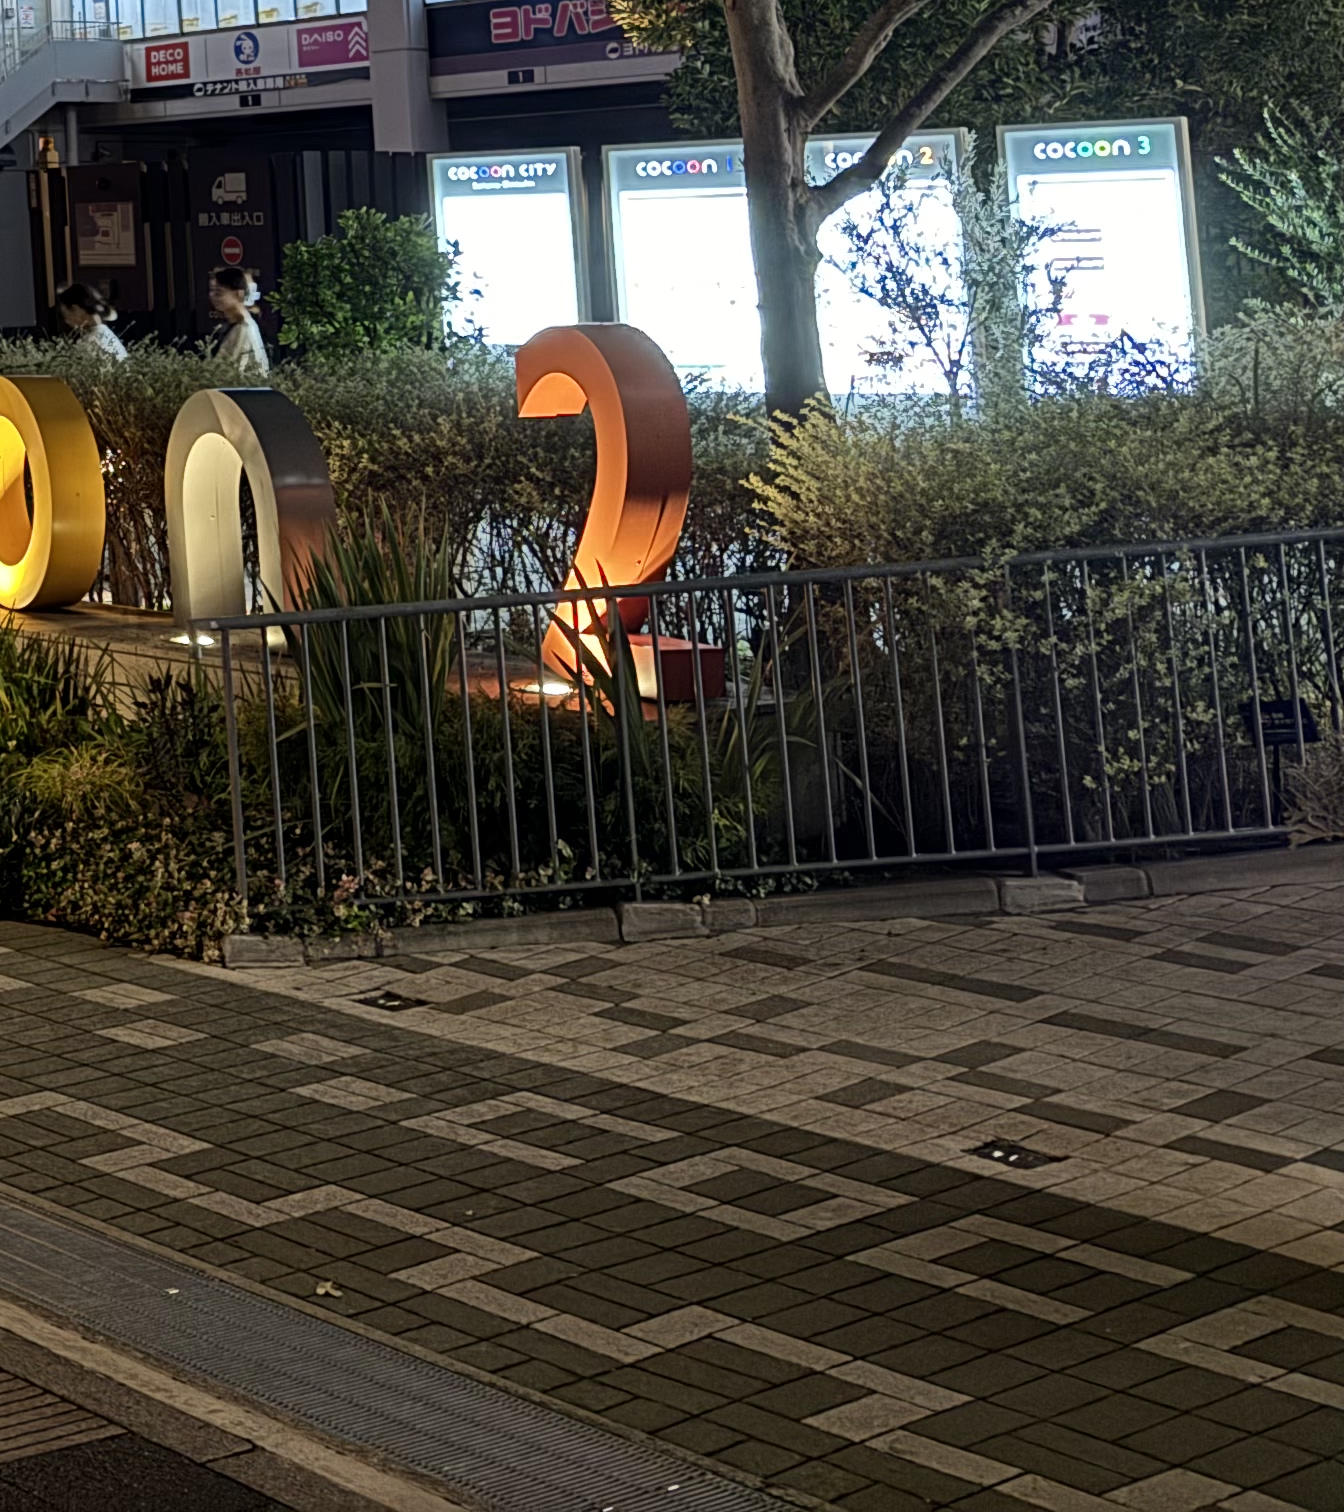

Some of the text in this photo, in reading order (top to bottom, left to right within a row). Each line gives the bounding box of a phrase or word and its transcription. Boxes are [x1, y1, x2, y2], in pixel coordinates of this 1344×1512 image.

[301, 29, 344, 46] DAISO
[150, 48, 184, 63] DECO
[151, 63, 185, 77] HOME
[1138, 136, 1151, 155] 3
[919, 147, 934, 165] 2
[519, 162, 557, 177] CITY
[515, 322, 726, 722] 2
